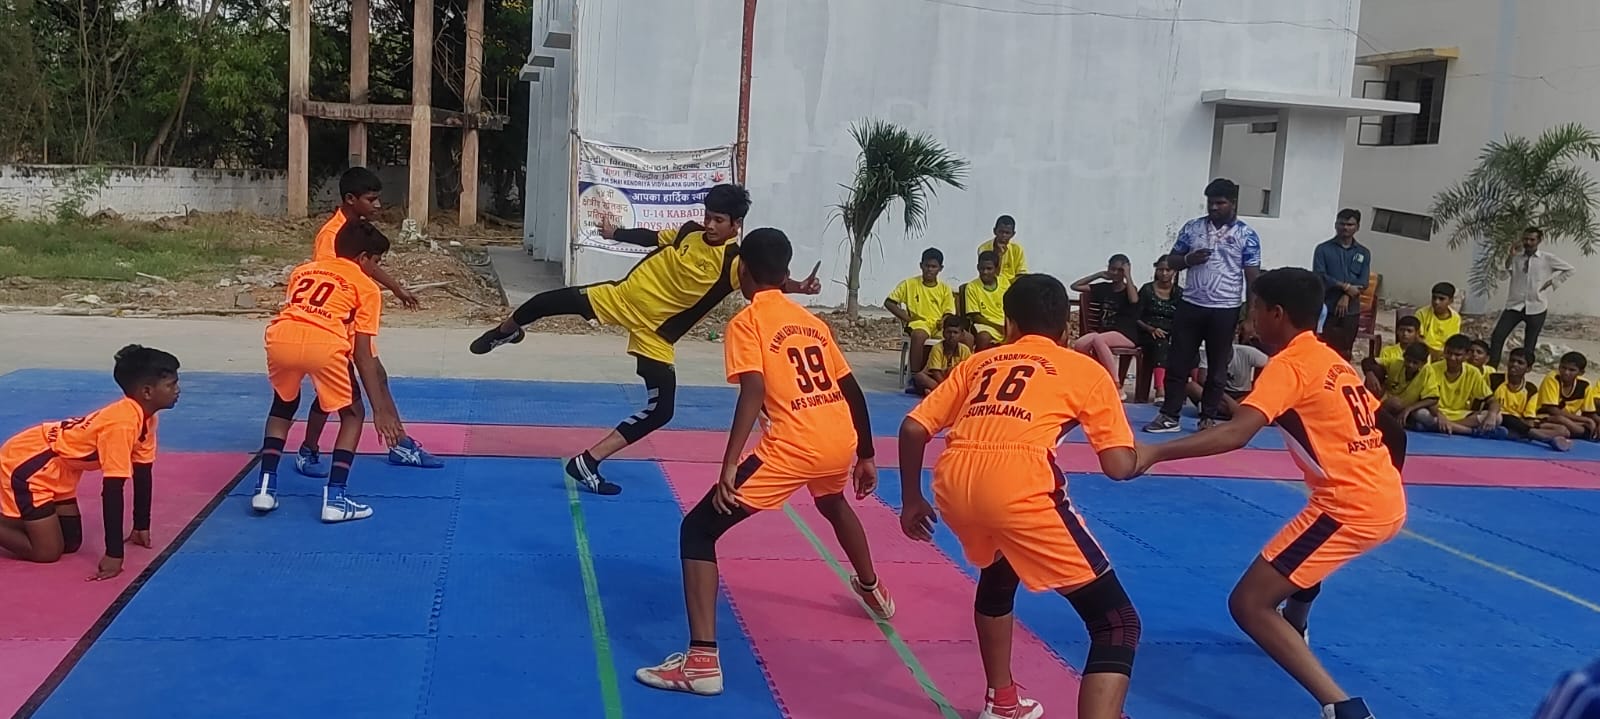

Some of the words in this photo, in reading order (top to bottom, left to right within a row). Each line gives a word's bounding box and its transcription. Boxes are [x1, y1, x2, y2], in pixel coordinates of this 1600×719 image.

[631, 192, 660, 202] आपका
[663, 191, 690, 203] हार्दिक
[643, 208, 664, 218] U-14
[637, 221, 662, 231] BOYS
[291, 278, 335, 307] 20
[786, 345, 832, 393] 39
[970, 365, 1035, 404] 16
[791, 396, 807, 411] AFS
[967, 404, 1032, 422] SURYALANKA
[1347, 441, 1367, 454] AFS
